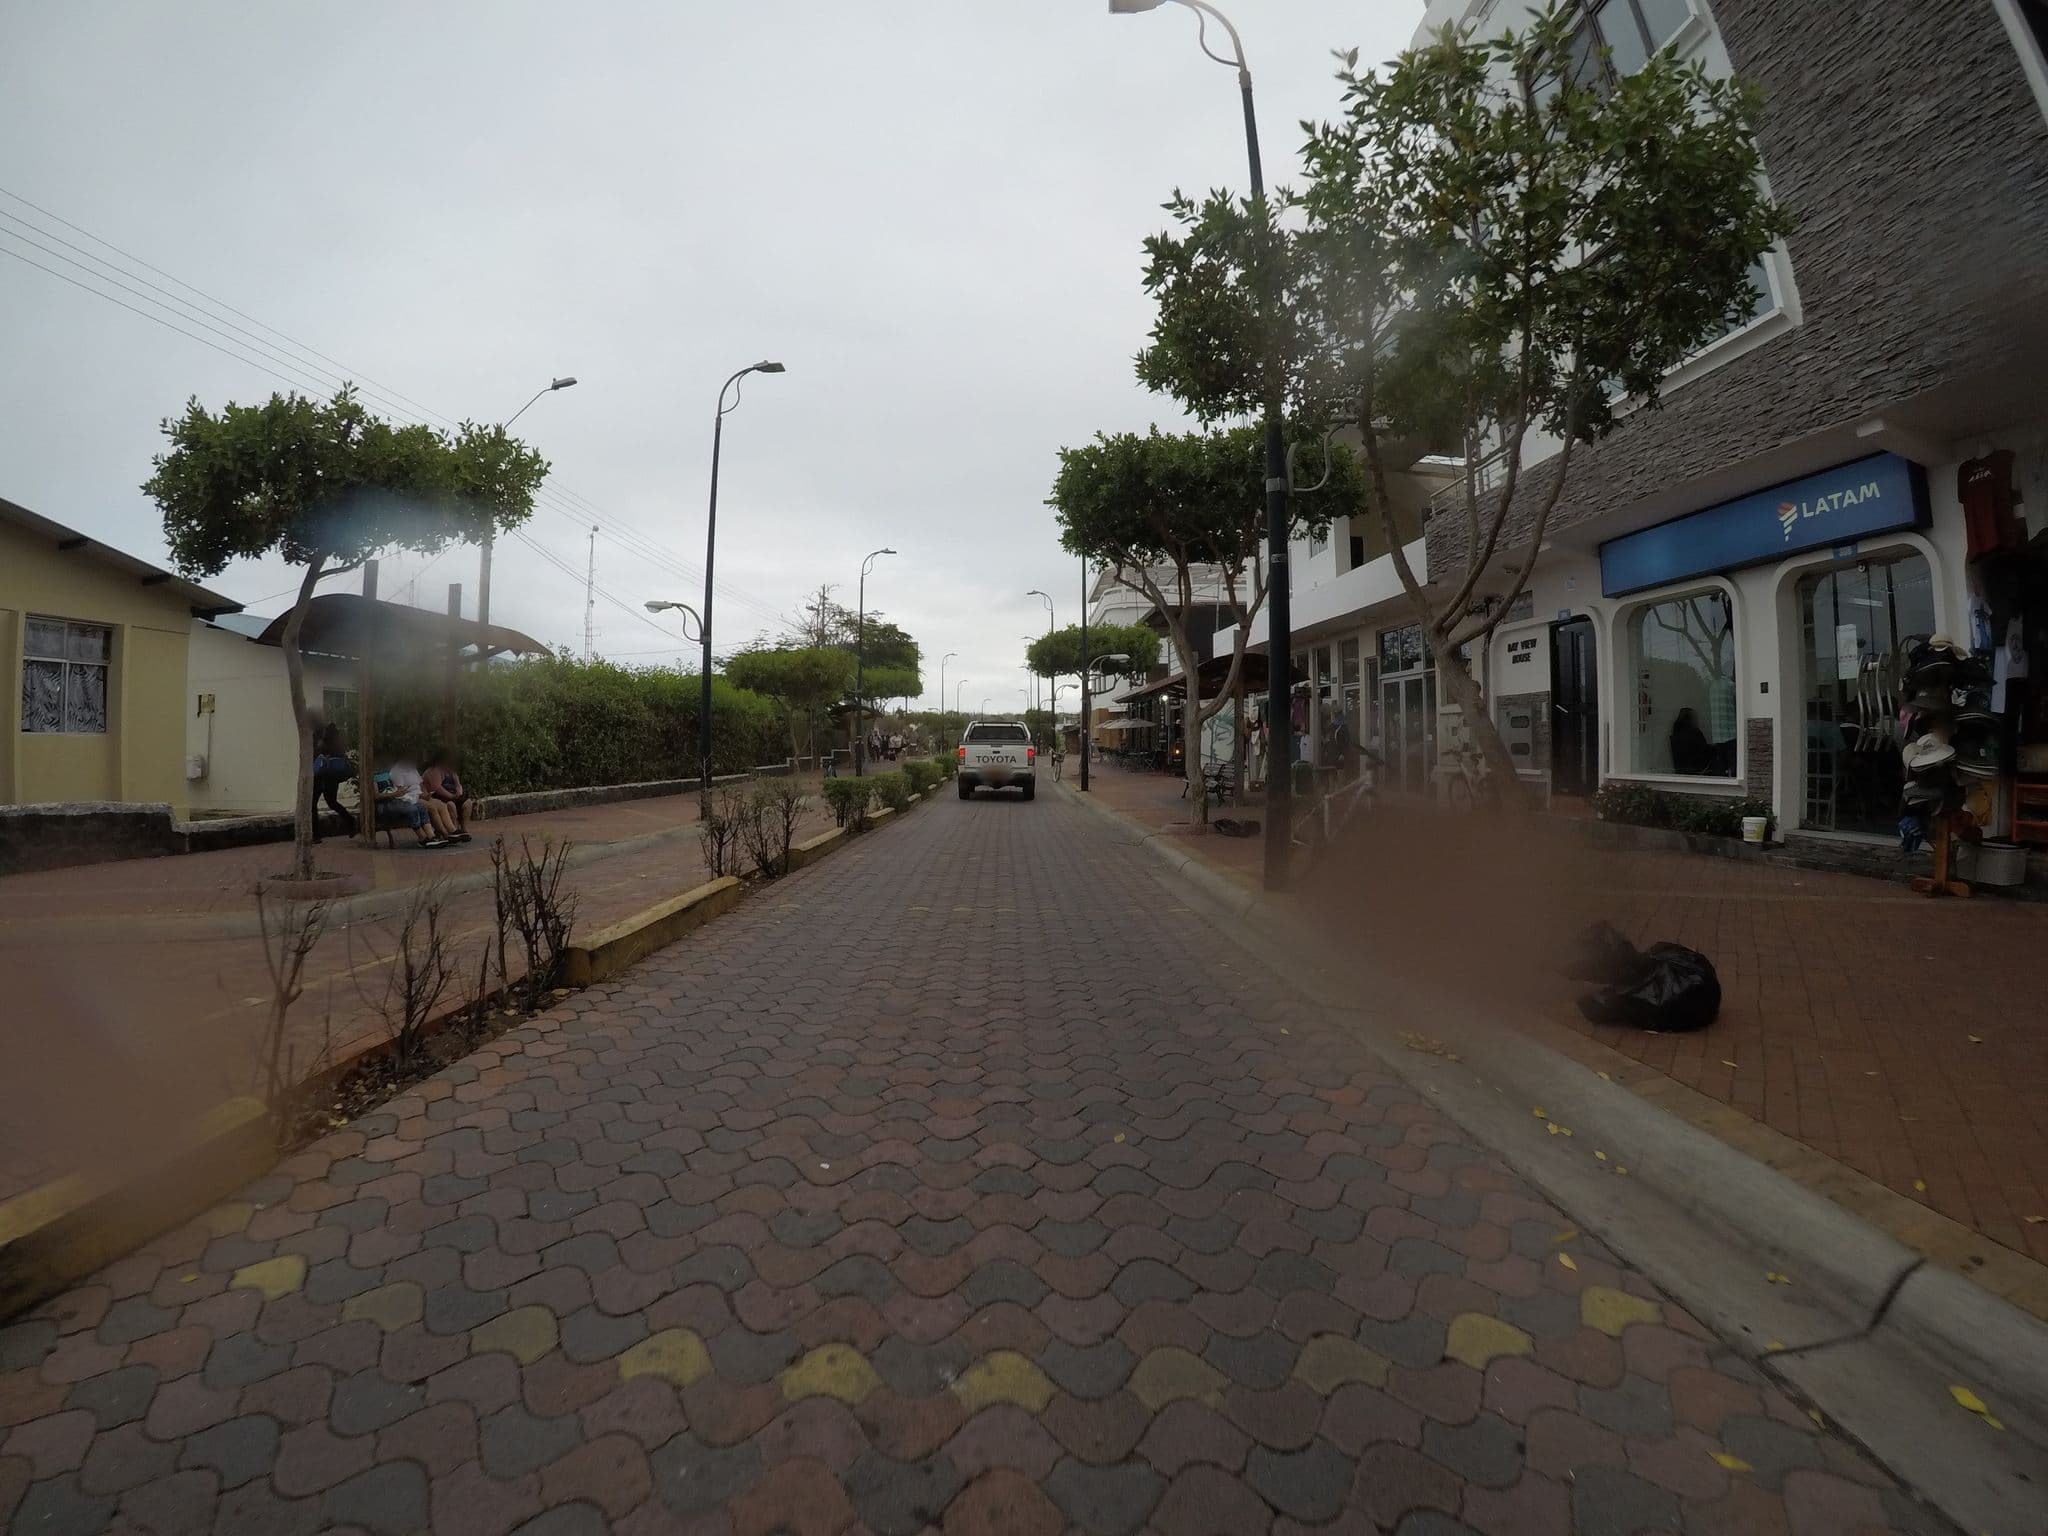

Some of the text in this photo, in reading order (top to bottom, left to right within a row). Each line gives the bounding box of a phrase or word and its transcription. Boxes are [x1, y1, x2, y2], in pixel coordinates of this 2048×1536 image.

[1802, 482, 1881, 518] LATAM
[1521, 638, 1537, 650] VIEW
[1512, 653, 1531, 664] HOUSE
[976, 755, 1017, 764] TOYOTA
